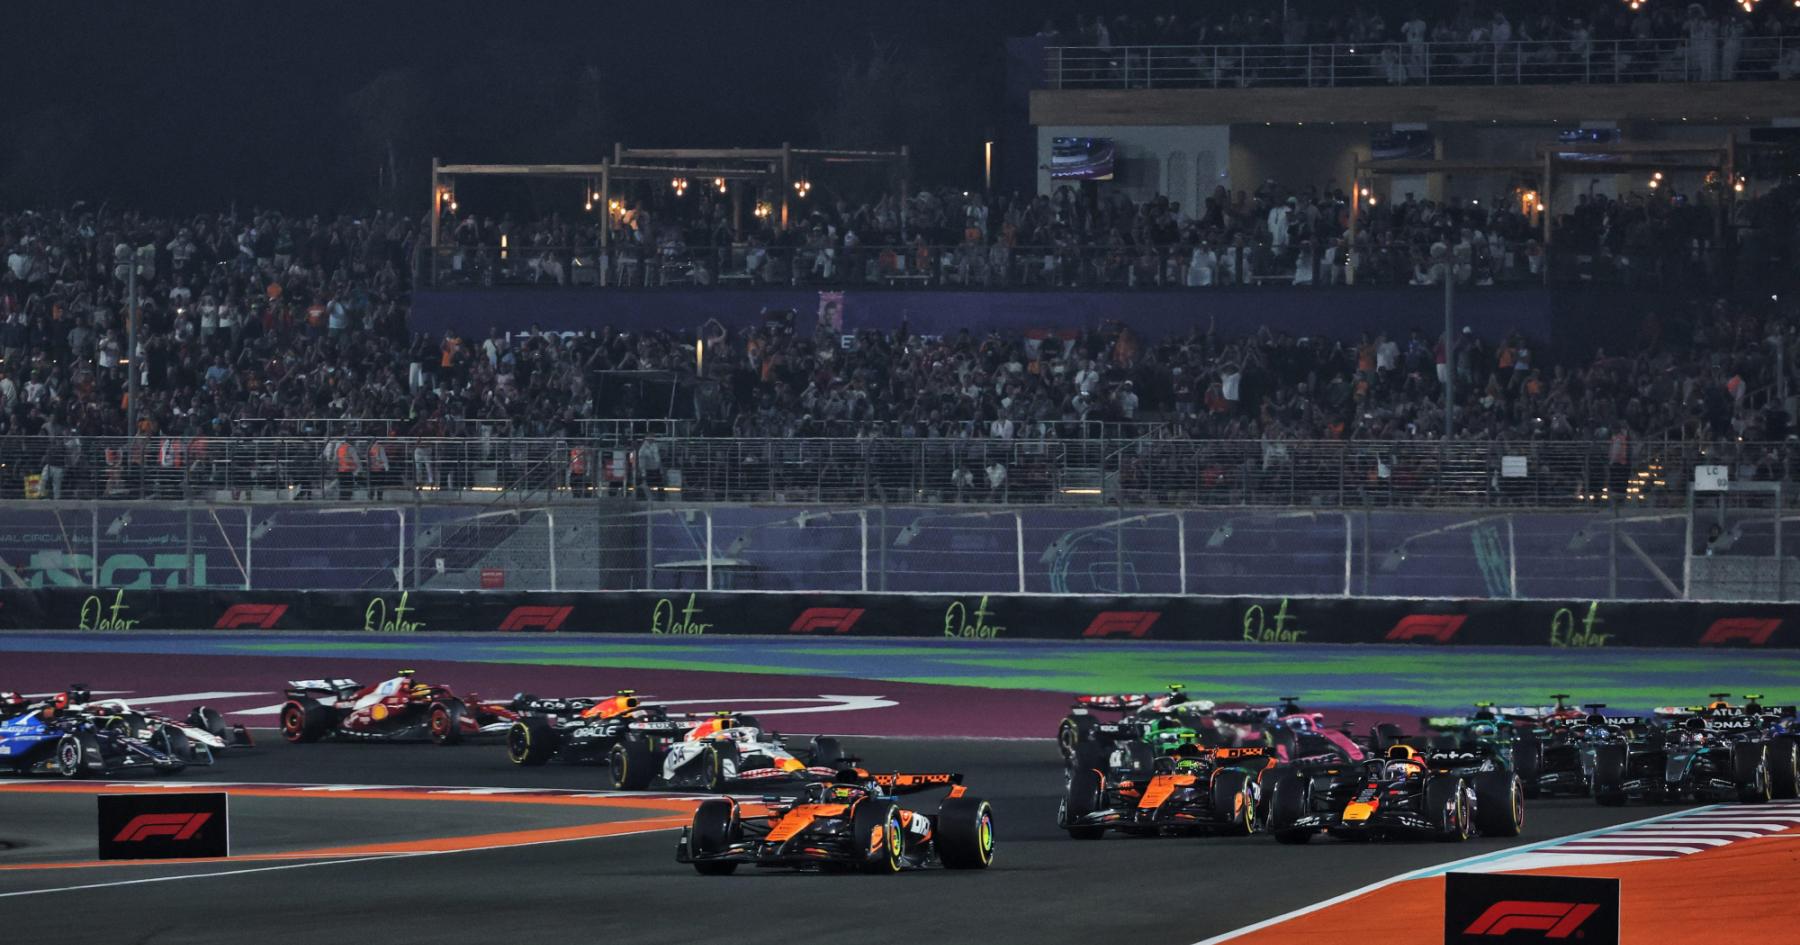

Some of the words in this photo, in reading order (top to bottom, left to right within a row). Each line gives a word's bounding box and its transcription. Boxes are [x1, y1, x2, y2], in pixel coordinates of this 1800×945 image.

[79, 588, 140, 631] Qatar
[214, 604, 289, 628] F1
[364, 590, 427, 632] Qatar
[499, 606, 574, 631] F1
[651, 592, 713, 634] Qatar
[789, 607, 865, 632] F1
[944, 595, 1007, 639] Qatar
[1082, 611, 1162, 637] F1
[1385, 614, 1468, 641] F1
[1698, 618, 1782, 644] F1
[574, 725, 616, 738] ORACLE
[113, 812, 213, 842] F1
[1462, 900, 1600, 938] F1
